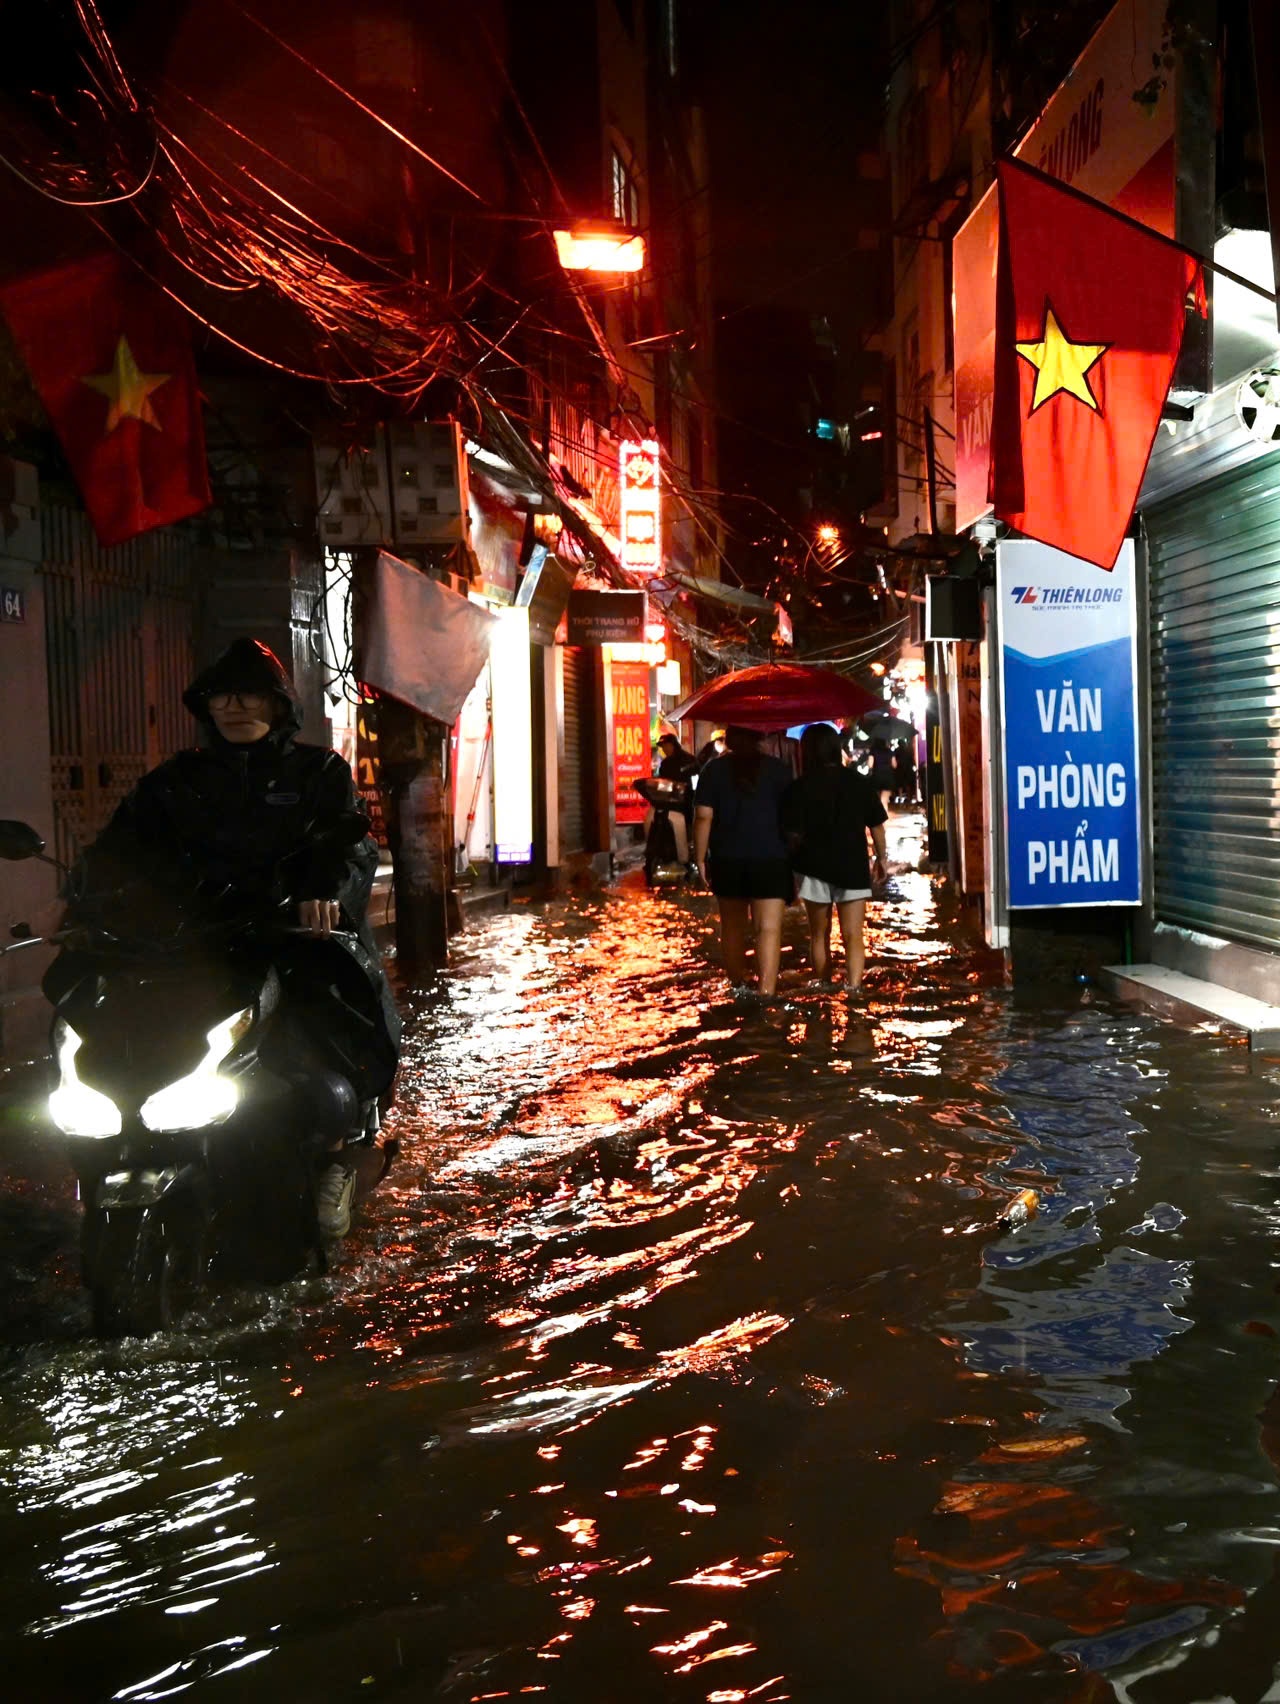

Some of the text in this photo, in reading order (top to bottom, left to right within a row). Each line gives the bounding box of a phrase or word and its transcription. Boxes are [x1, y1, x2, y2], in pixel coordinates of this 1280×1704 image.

[5, 591, 21, 617] 64
[612, 680, 646, 715] VÀNG
[1035, 680, 1102, 733] VĂN
[616, 725, 643, 763] BẠC
[1017, 750, 1127, 810] PHÒNG
[1028, 819, 1120, 886] PHẨM
